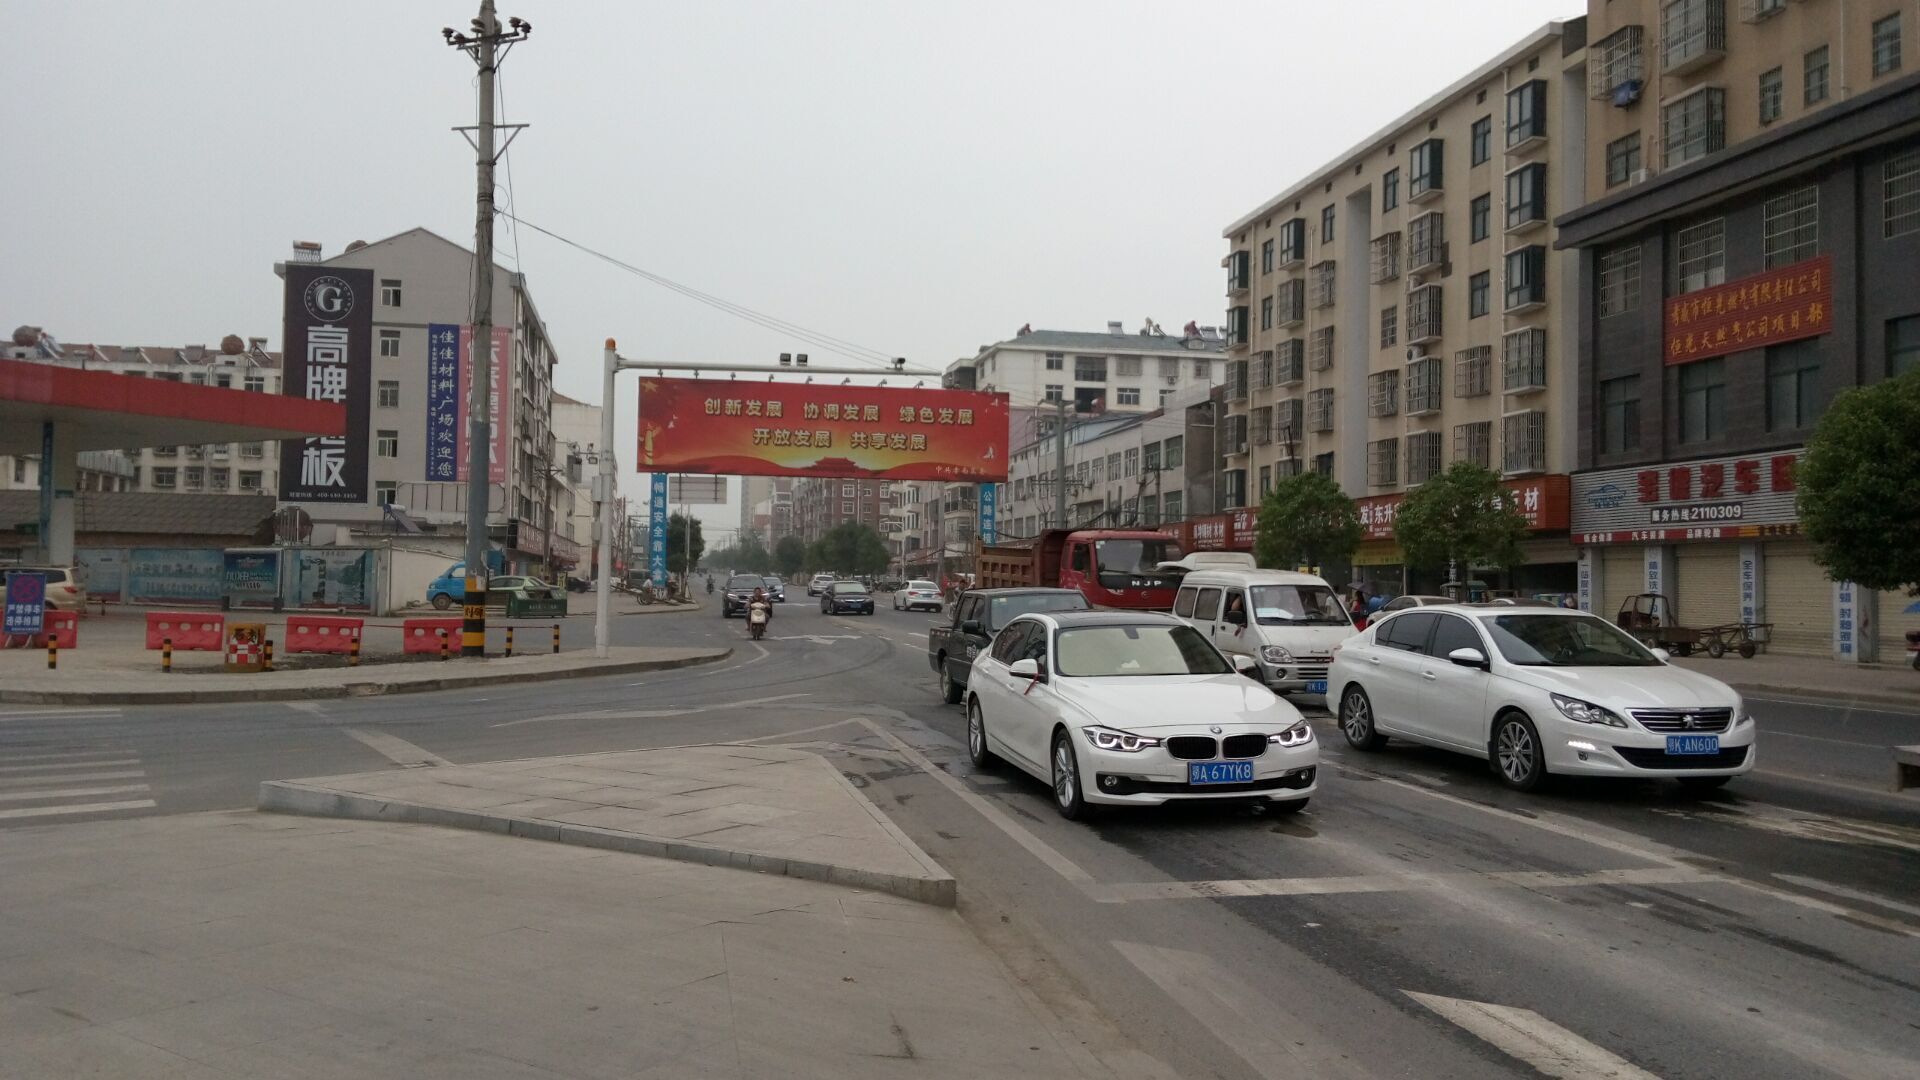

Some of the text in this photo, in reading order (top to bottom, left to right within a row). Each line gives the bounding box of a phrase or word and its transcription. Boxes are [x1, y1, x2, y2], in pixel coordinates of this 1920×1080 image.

[301, 323, 349, 487] 高牌板
[437, 330, 455, 477] 佳佳材料广场欢迎您
[704, 397, 976, 426] 创新发展 协调发展 绿色发展
[752, 427, 928, 452] 开放发展 共享发展
[1685, 526, 1721, 539] 品牌轮胎
[1131, 579, 1163, 587] NJP
[1648, 561, 1658, 593] 精致洗
[7, 604, 41, 614] 严禁停车
